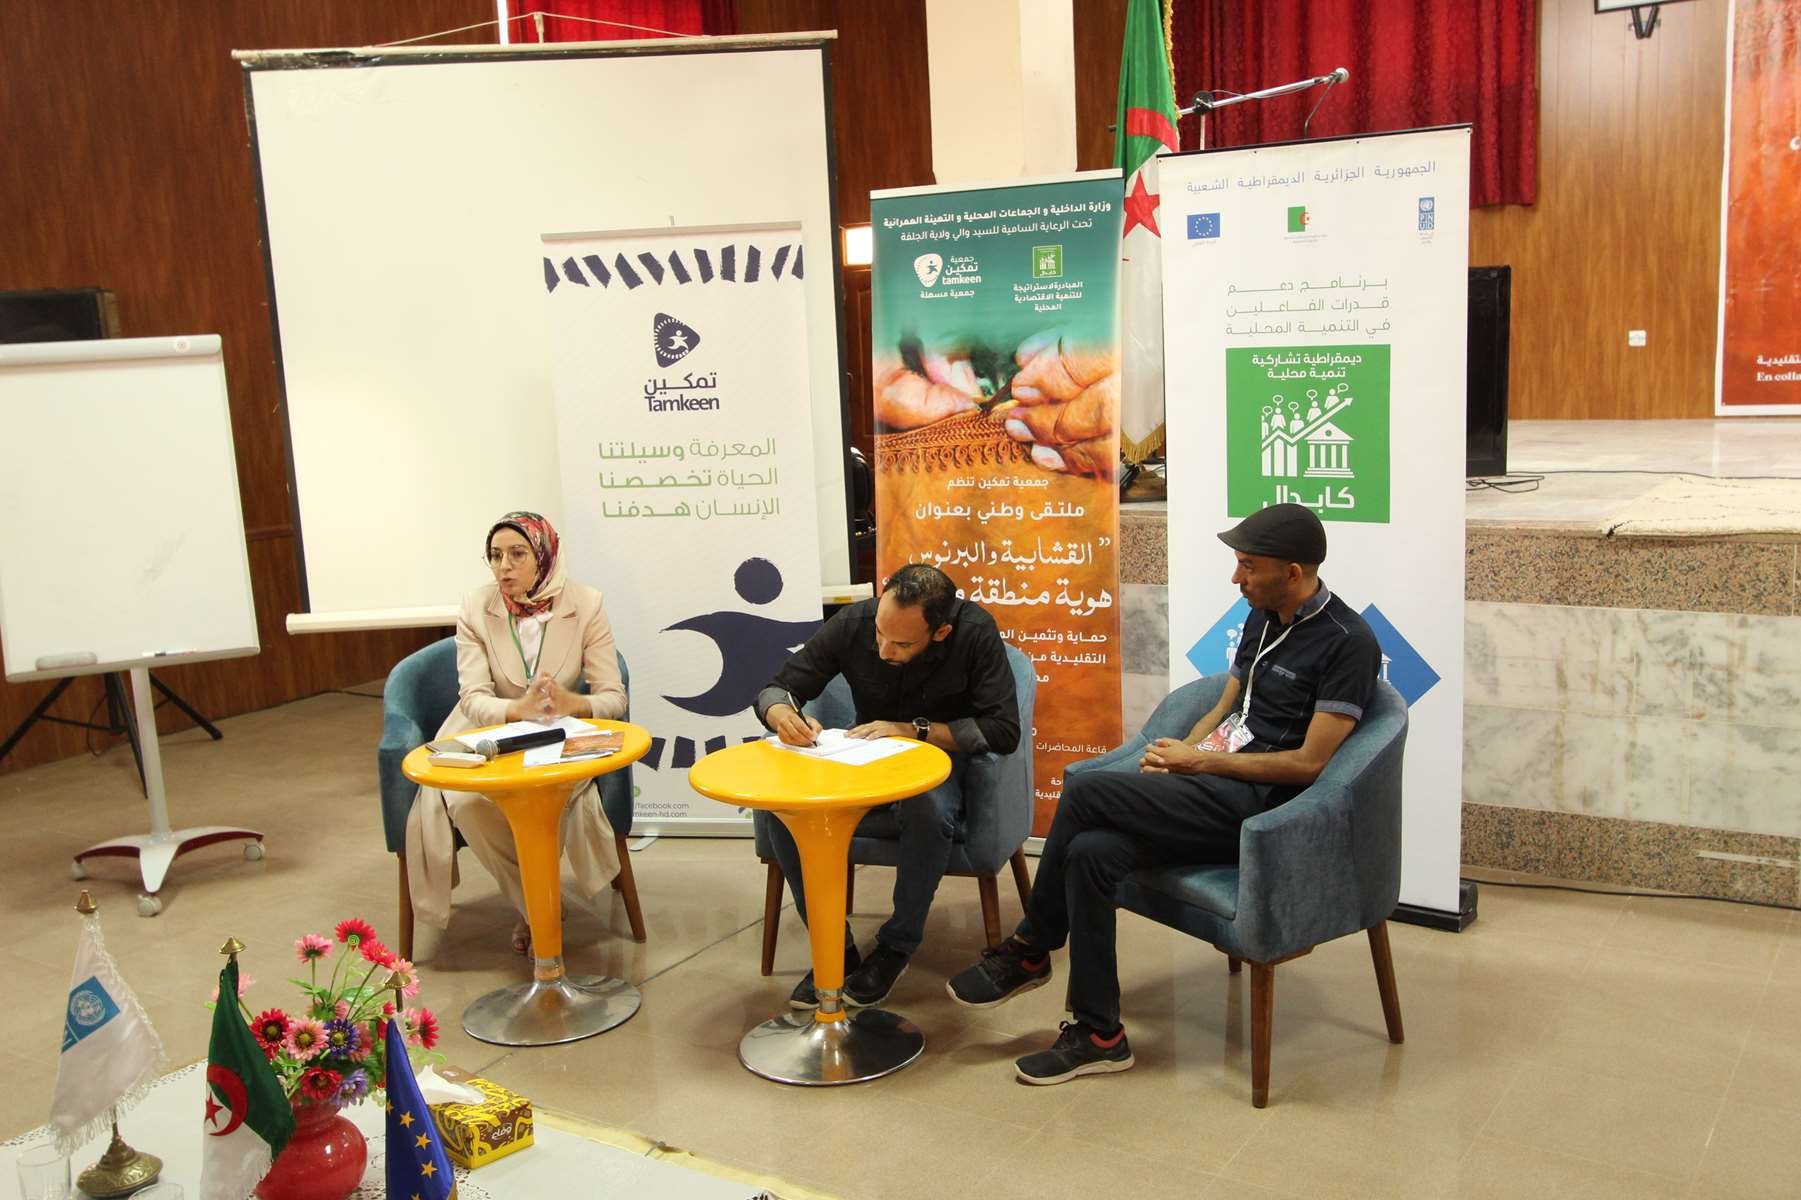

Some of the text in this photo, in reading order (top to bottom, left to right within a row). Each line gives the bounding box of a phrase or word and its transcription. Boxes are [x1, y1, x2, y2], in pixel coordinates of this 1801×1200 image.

[1187, 160, 1436, 195] الجمهورية الجزائرية الديمقراطية الشعبية
[999, 207, 1040, 218] الجماعات
[1050, 203, 1086, 215] الداخلية
[1089, 201, 1111, 212] وزارة
[883, 217, 922, 229] العمرانية
[963, 210, 996, 222] المحلية
[900, 218, 1092, 242] تحت الرعاية السامية للسيد والي ولاية الجلفة
[945, 262, 979, 276] تمكين
[942, 274, 981, 285] tamkeen
[1228, 274, 1388, 296] برنامج دعم
[1226, 296, 1390, 318] قدرات الفاعلين
[1225, 318, 1391, 339] في التنمية المحلية
[1252, 352, 1362, 367] ديمقراطية تشاركية
[1267, 367, 1346, 381] تنمية محلية
[644, 371, 717, 396] تمكين
[644, 394, 720, 412] Tamkeen
[689, 437, 776, 461] المعرفة
[599, 467, 778, 489] الحياة تخصصنا
[947, 476, 1049, 491] جمعية تمكين تنظم
[602, 497, 780, 521] الإنسان هدفنا
[915, 501, 1085, 525] ملتقى وطني بعنوان
[970, 575, 1113, 616] هوية منطقة
[1018, 628, 1064, 643] وتثمين
[1066, 630, 1107, 645] حماية
[1050, 651, 1106, 666] التقليدية
[1036, 742, 1107, 754] قاعة المحاضرات
